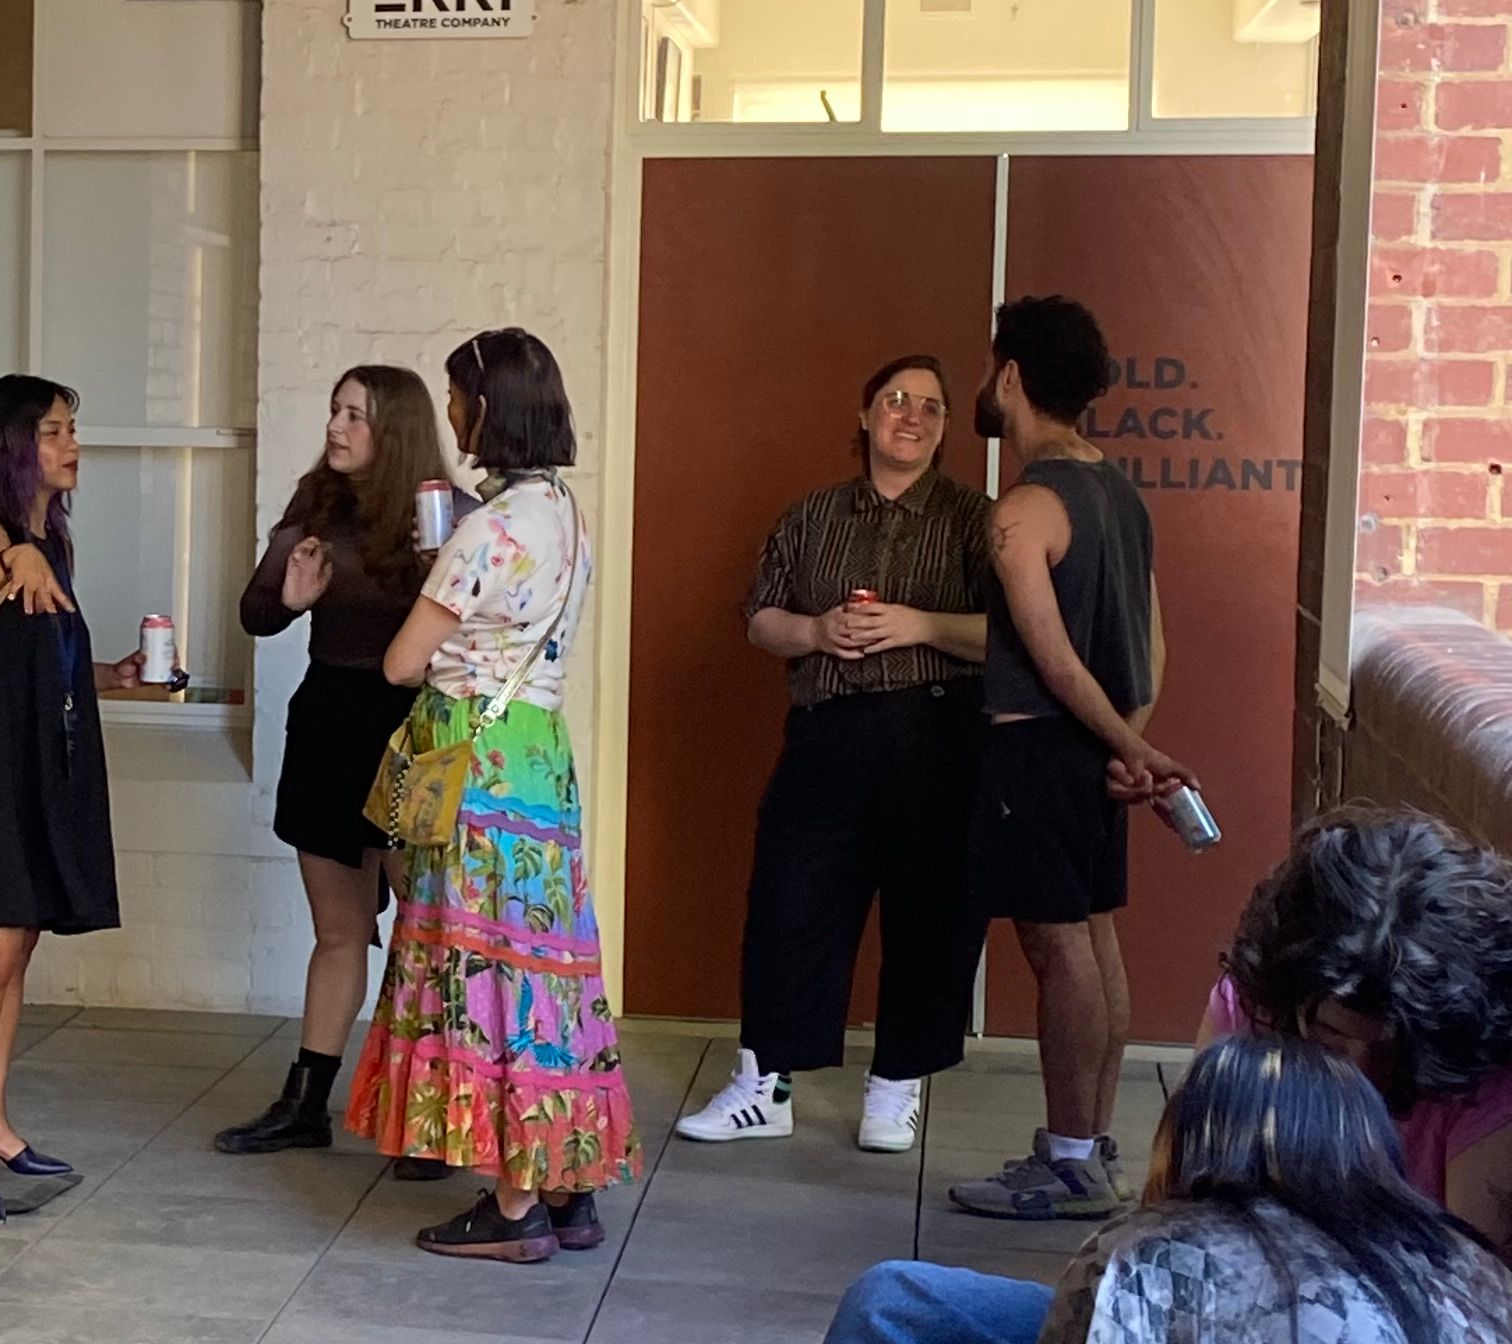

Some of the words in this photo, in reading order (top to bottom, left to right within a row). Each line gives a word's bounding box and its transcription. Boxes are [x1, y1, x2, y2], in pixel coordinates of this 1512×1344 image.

[375, 18, 437, 30] THEATRE
[440, 16, 511, 29] COMPANY
[1105, 357, 1199, 389] LD.
[1085, 408, 1224, 441] LACK.
[1118, 457, 1304, 491] LLIANT
